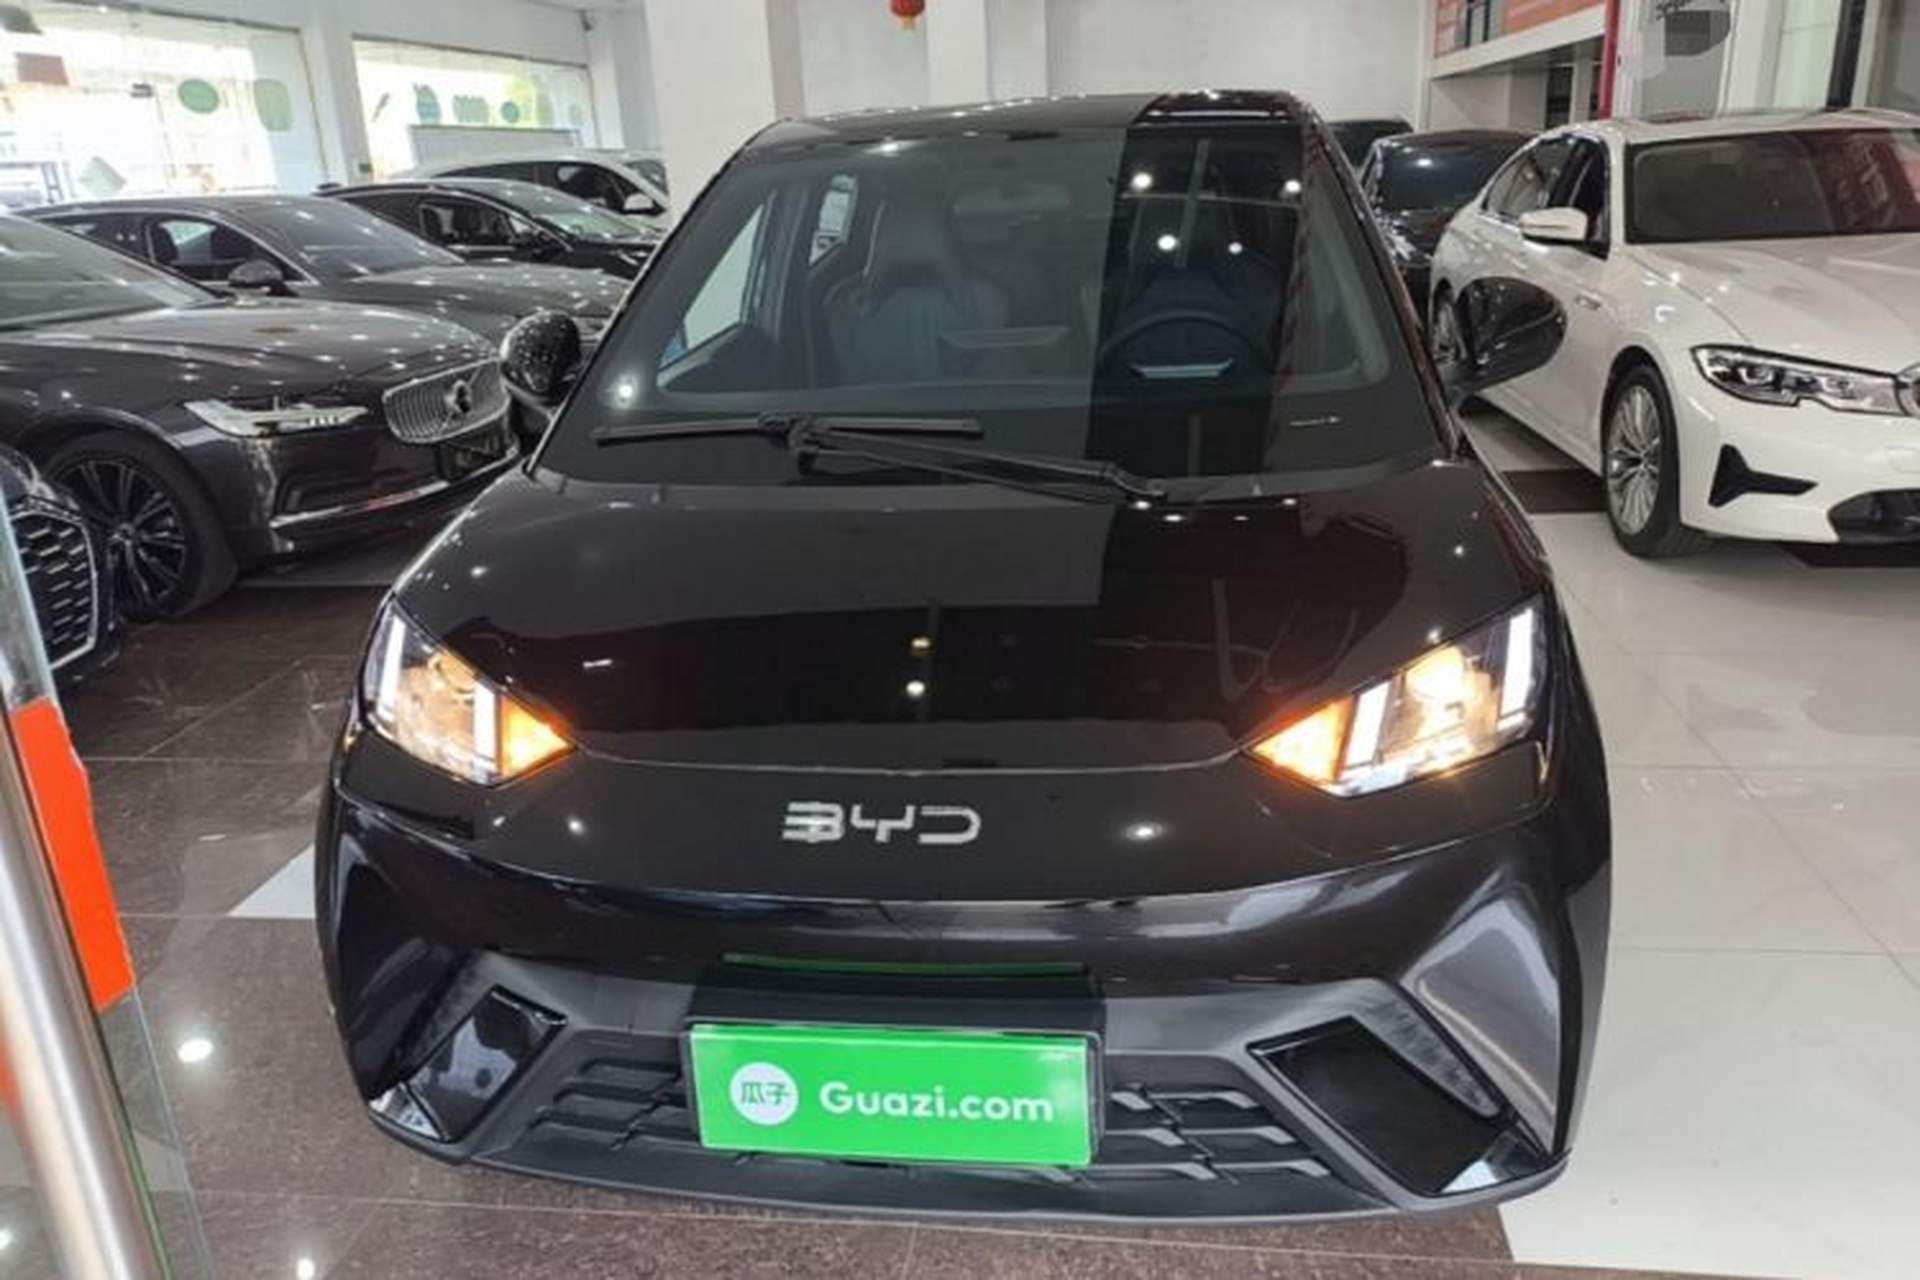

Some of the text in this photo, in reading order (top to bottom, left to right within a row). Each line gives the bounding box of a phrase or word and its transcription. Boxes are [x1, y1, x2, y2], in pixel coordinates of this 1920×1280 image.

[782, 801, 982, 845] BYD
[740, 1080, 1054, 1122] 瓜子 Guazi.com
